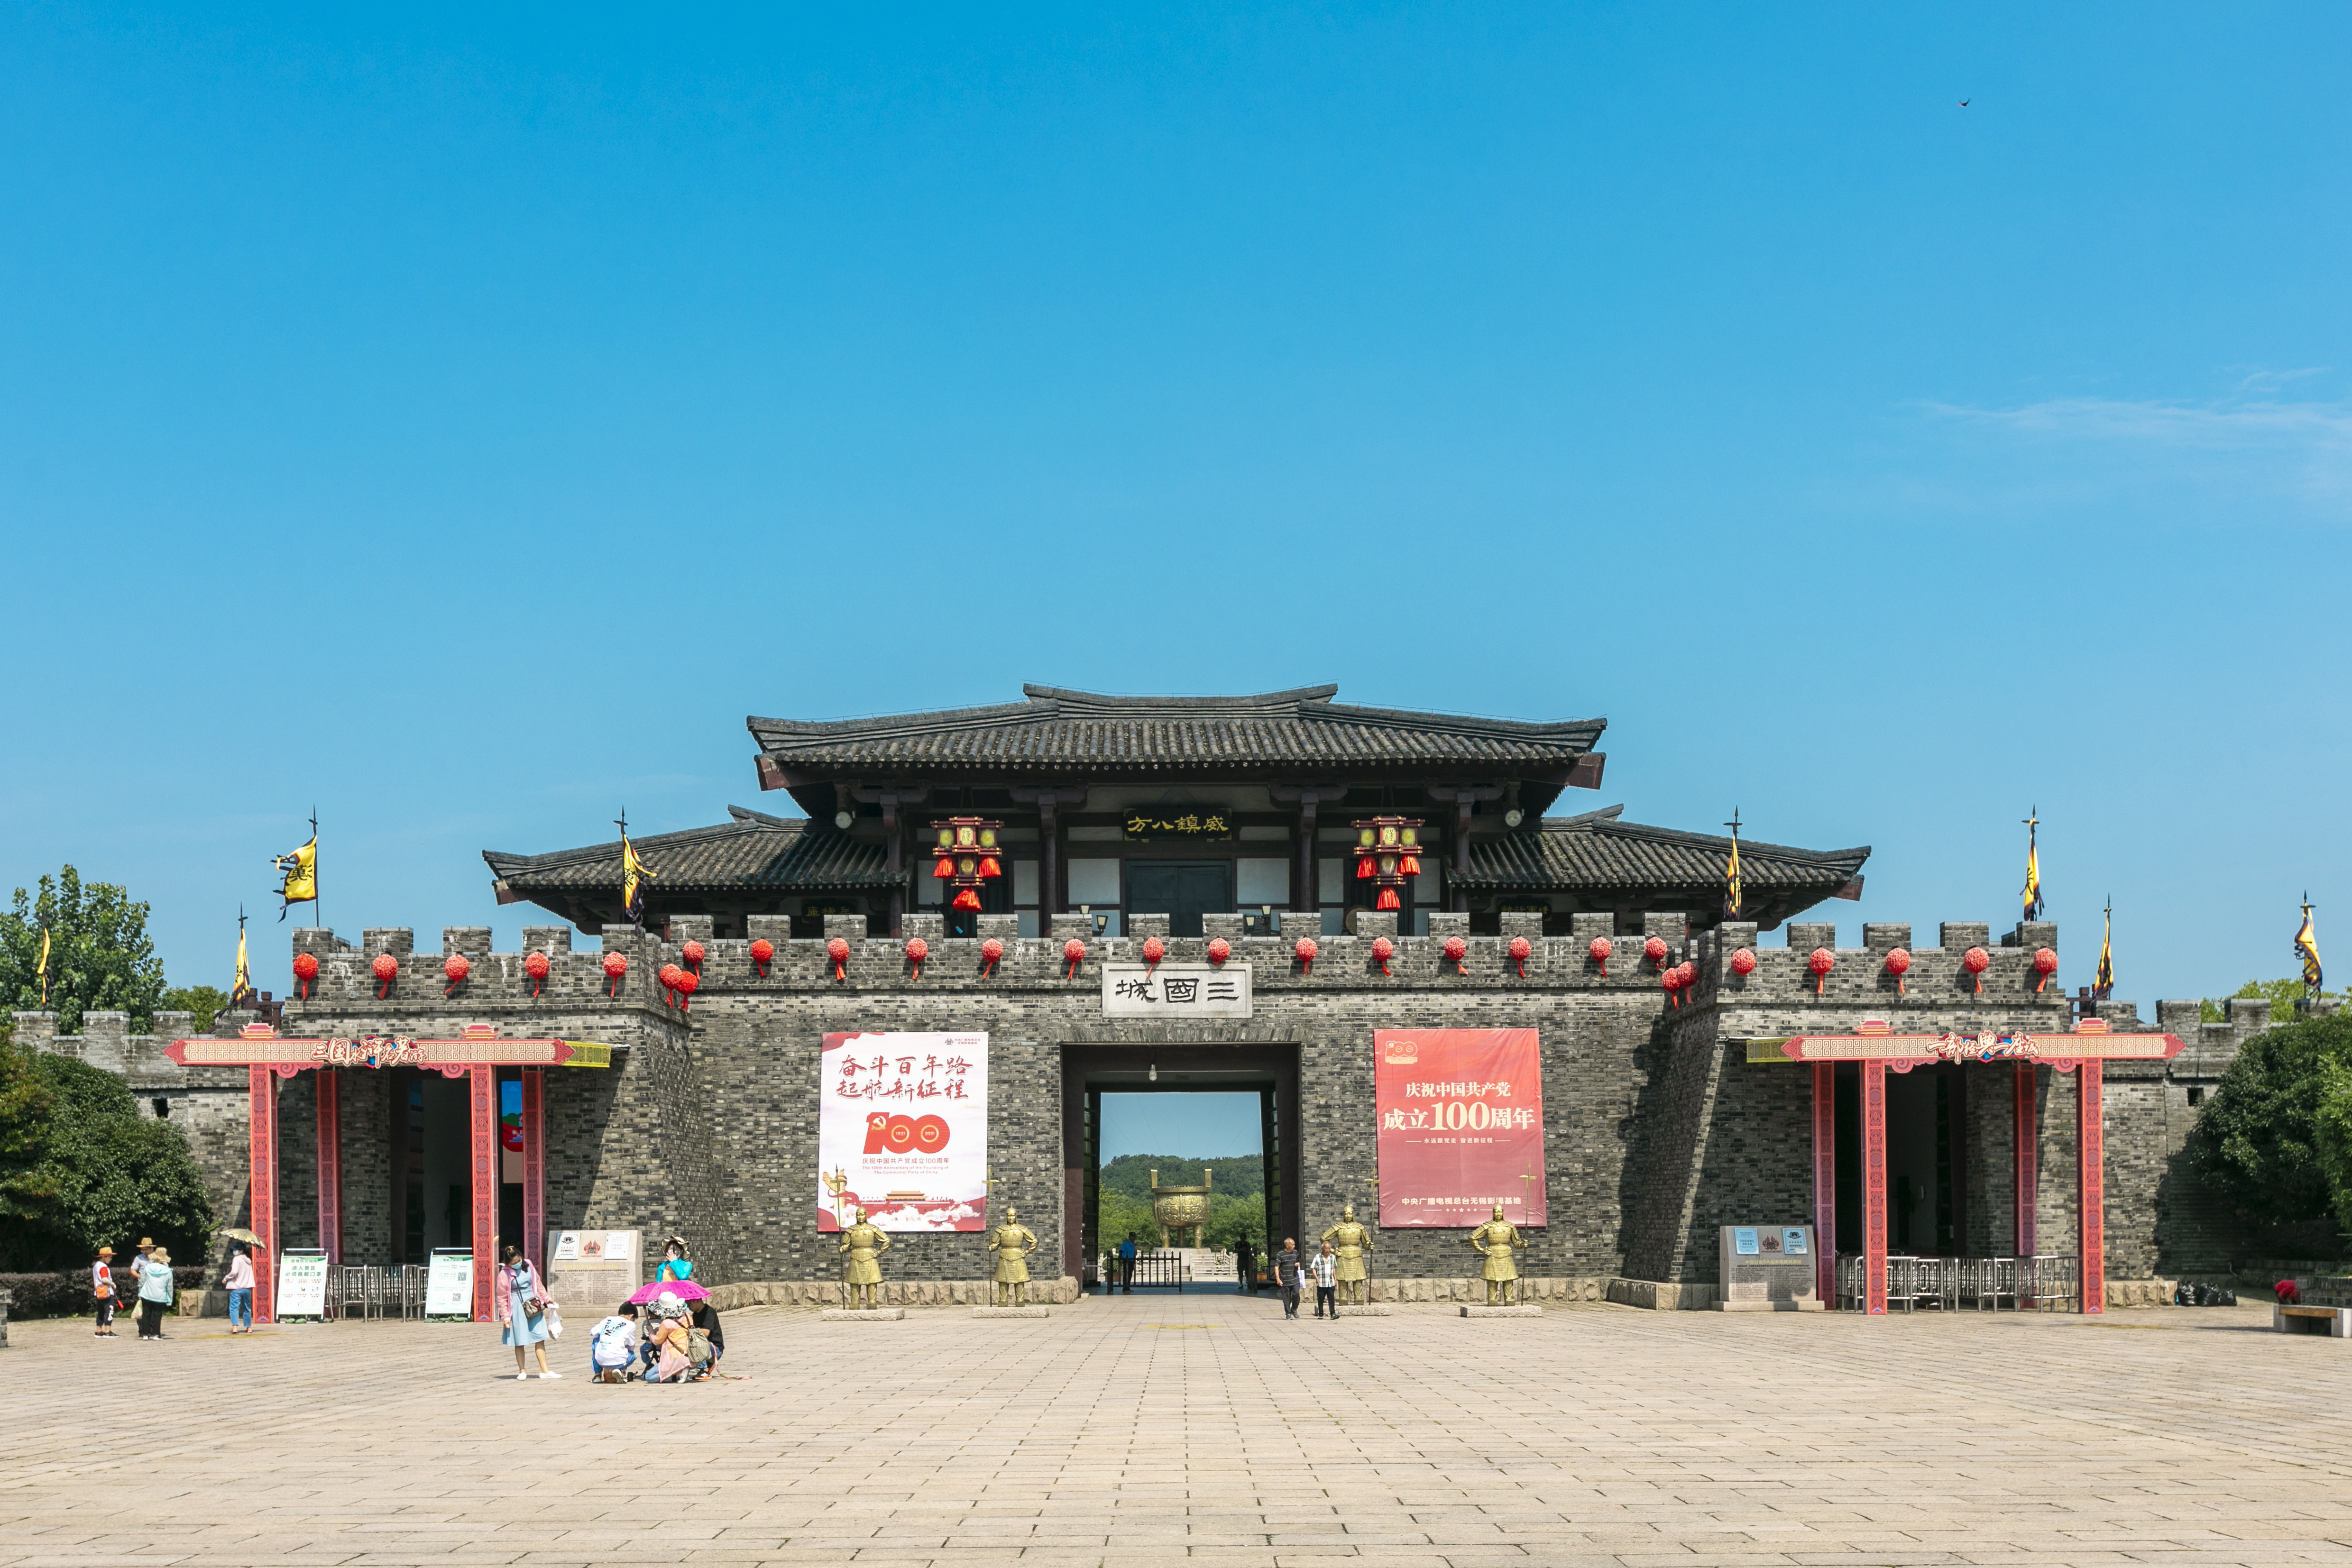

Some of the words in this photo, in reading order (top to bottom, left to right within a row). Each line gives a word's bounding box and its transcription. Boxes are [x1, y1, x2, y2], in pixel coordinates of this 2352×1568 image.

[312, 1036, 427, 1068] 三国水浒名著游
[1928, 1031, 2040, 1064] 一部经典一座城
[839, 1054, 974, 1078] 奋斗百年路
[836, 1078, 969, 1102] 起航新征程
[1405, 1082, 1511, 1097] 庆祝中国共产党
[1383, 1101, 1535, 1130] 成立100周年
[1402, 1197, 1522, 1205] 中央广播电视总台无锡影视基地
